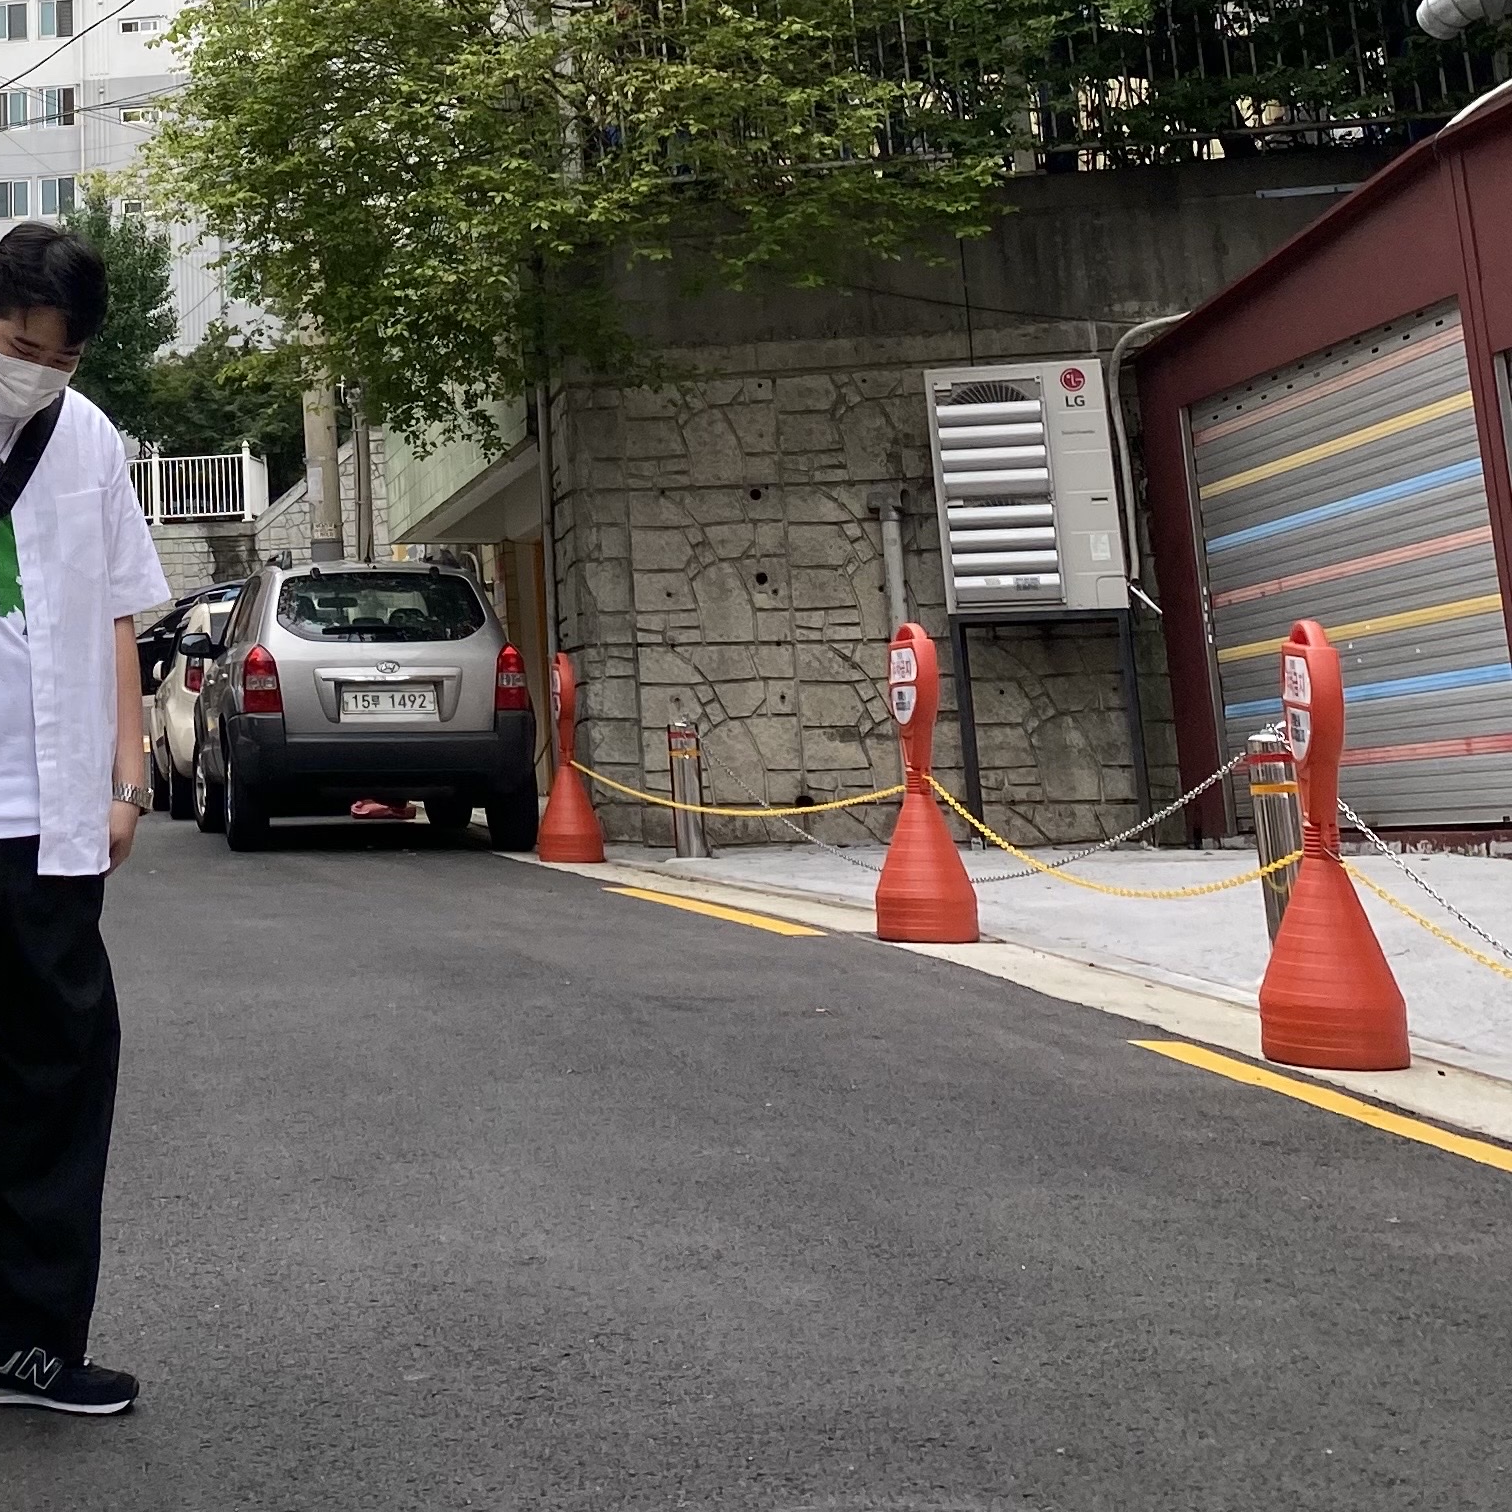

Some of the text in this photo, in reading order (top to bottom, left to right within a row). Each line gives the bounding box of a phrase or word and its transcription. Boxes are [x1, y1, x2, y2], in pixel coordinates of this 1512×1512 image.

[1065, 395, 1085, 407] LG
[388, 694, 427, 709] 1492
[15, 1346, 65, 1390] N
